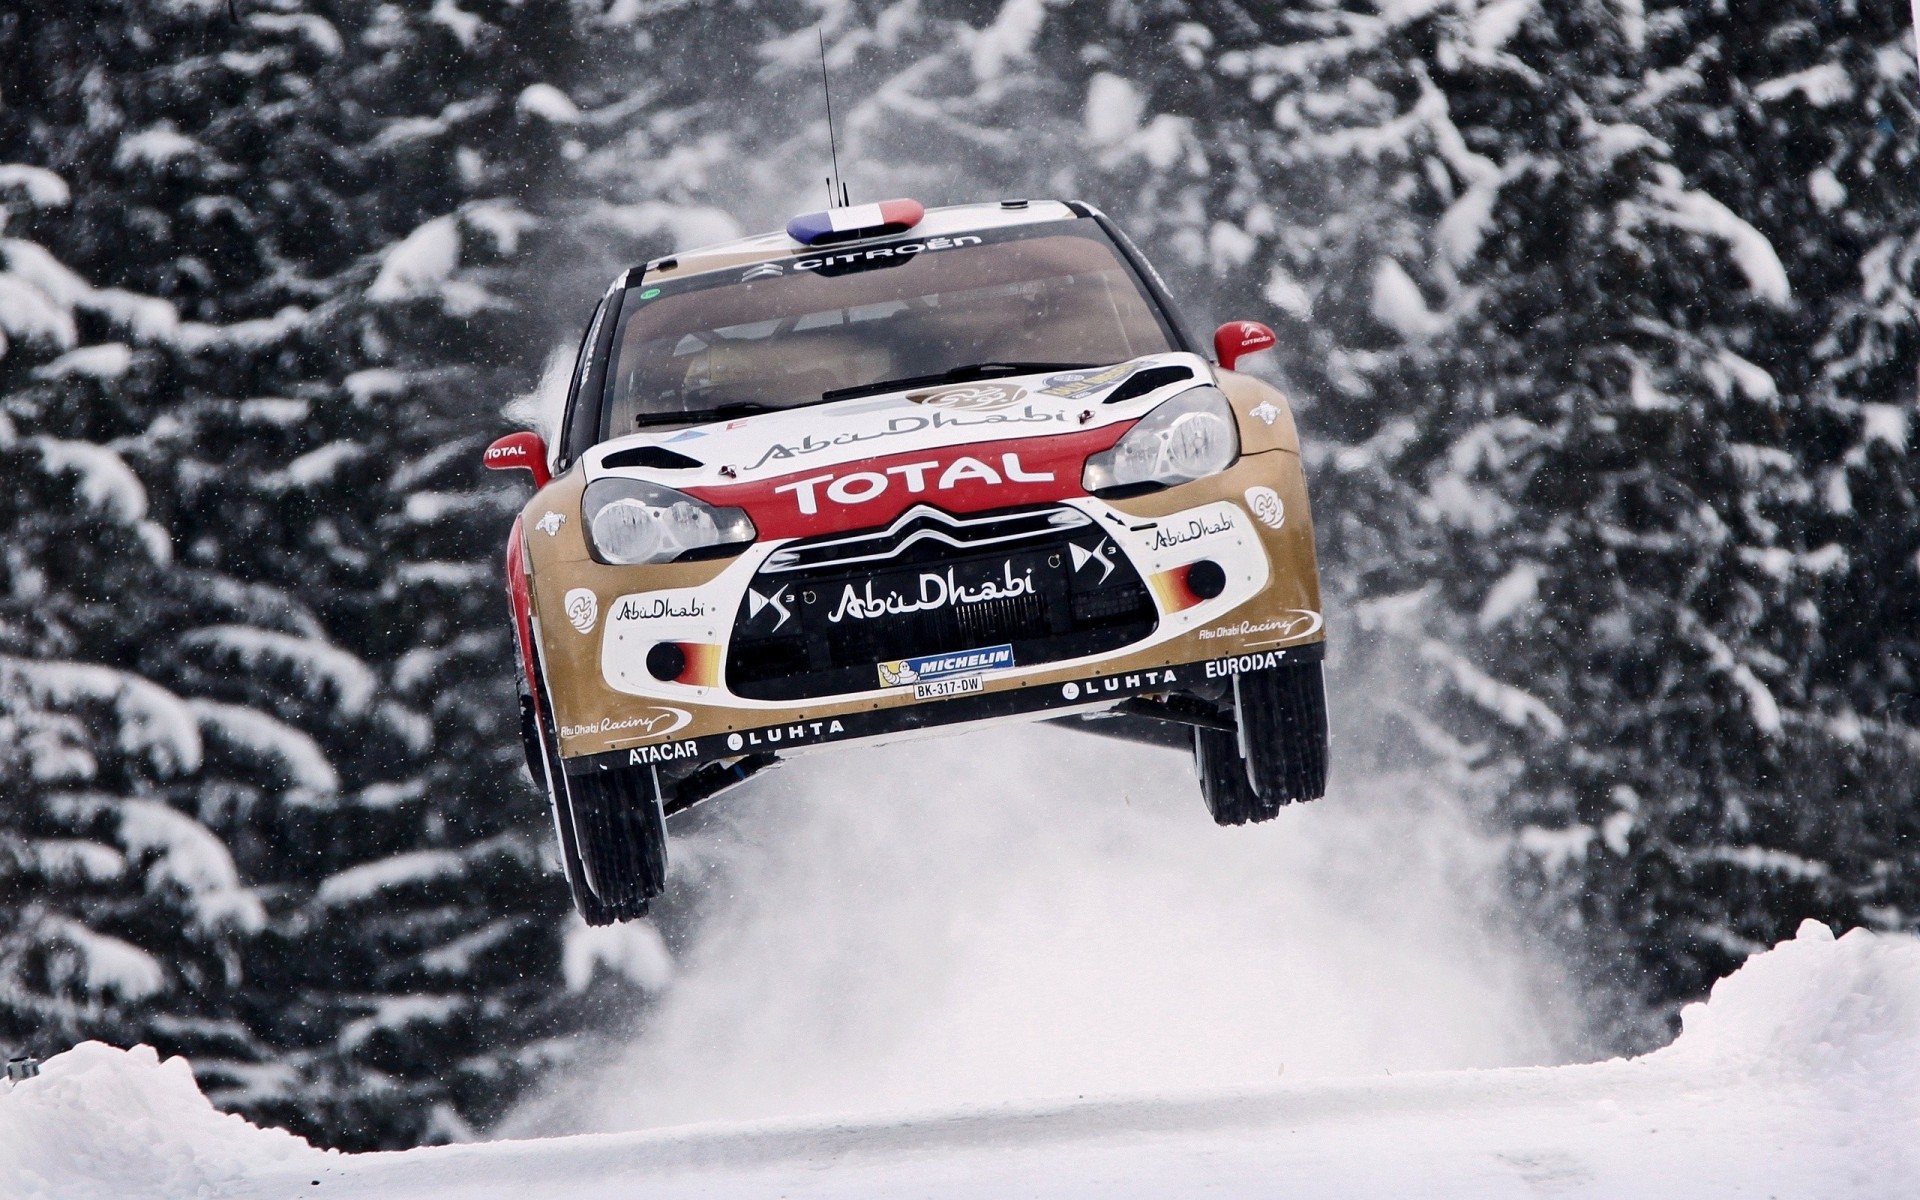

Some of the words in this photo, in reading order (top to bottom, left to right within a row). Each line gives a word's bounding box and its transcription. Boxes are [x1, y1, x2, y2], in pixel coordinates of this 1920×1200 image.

[488, 446, 526, 459] TOTAL
[775, 453, 1055, 515] TOTAL
[1199, 628, 1215, 640] Abu
[1216, 624, 1240, 638] Dhabi
[1240, 617, 1308, 635] Racing
[920, 650, 1009, 673] MICHELIN
[1206, 650, 1286, 679] EURODAT
[918, 678, 978, 697] BK-317-DW
[1086, 669, 1177, 694] LUHTA
[600, 713, 670, 732] Racing
[749, 720, 845, 745] LUHTA
[629, 741, 698, 765] ATACAR
